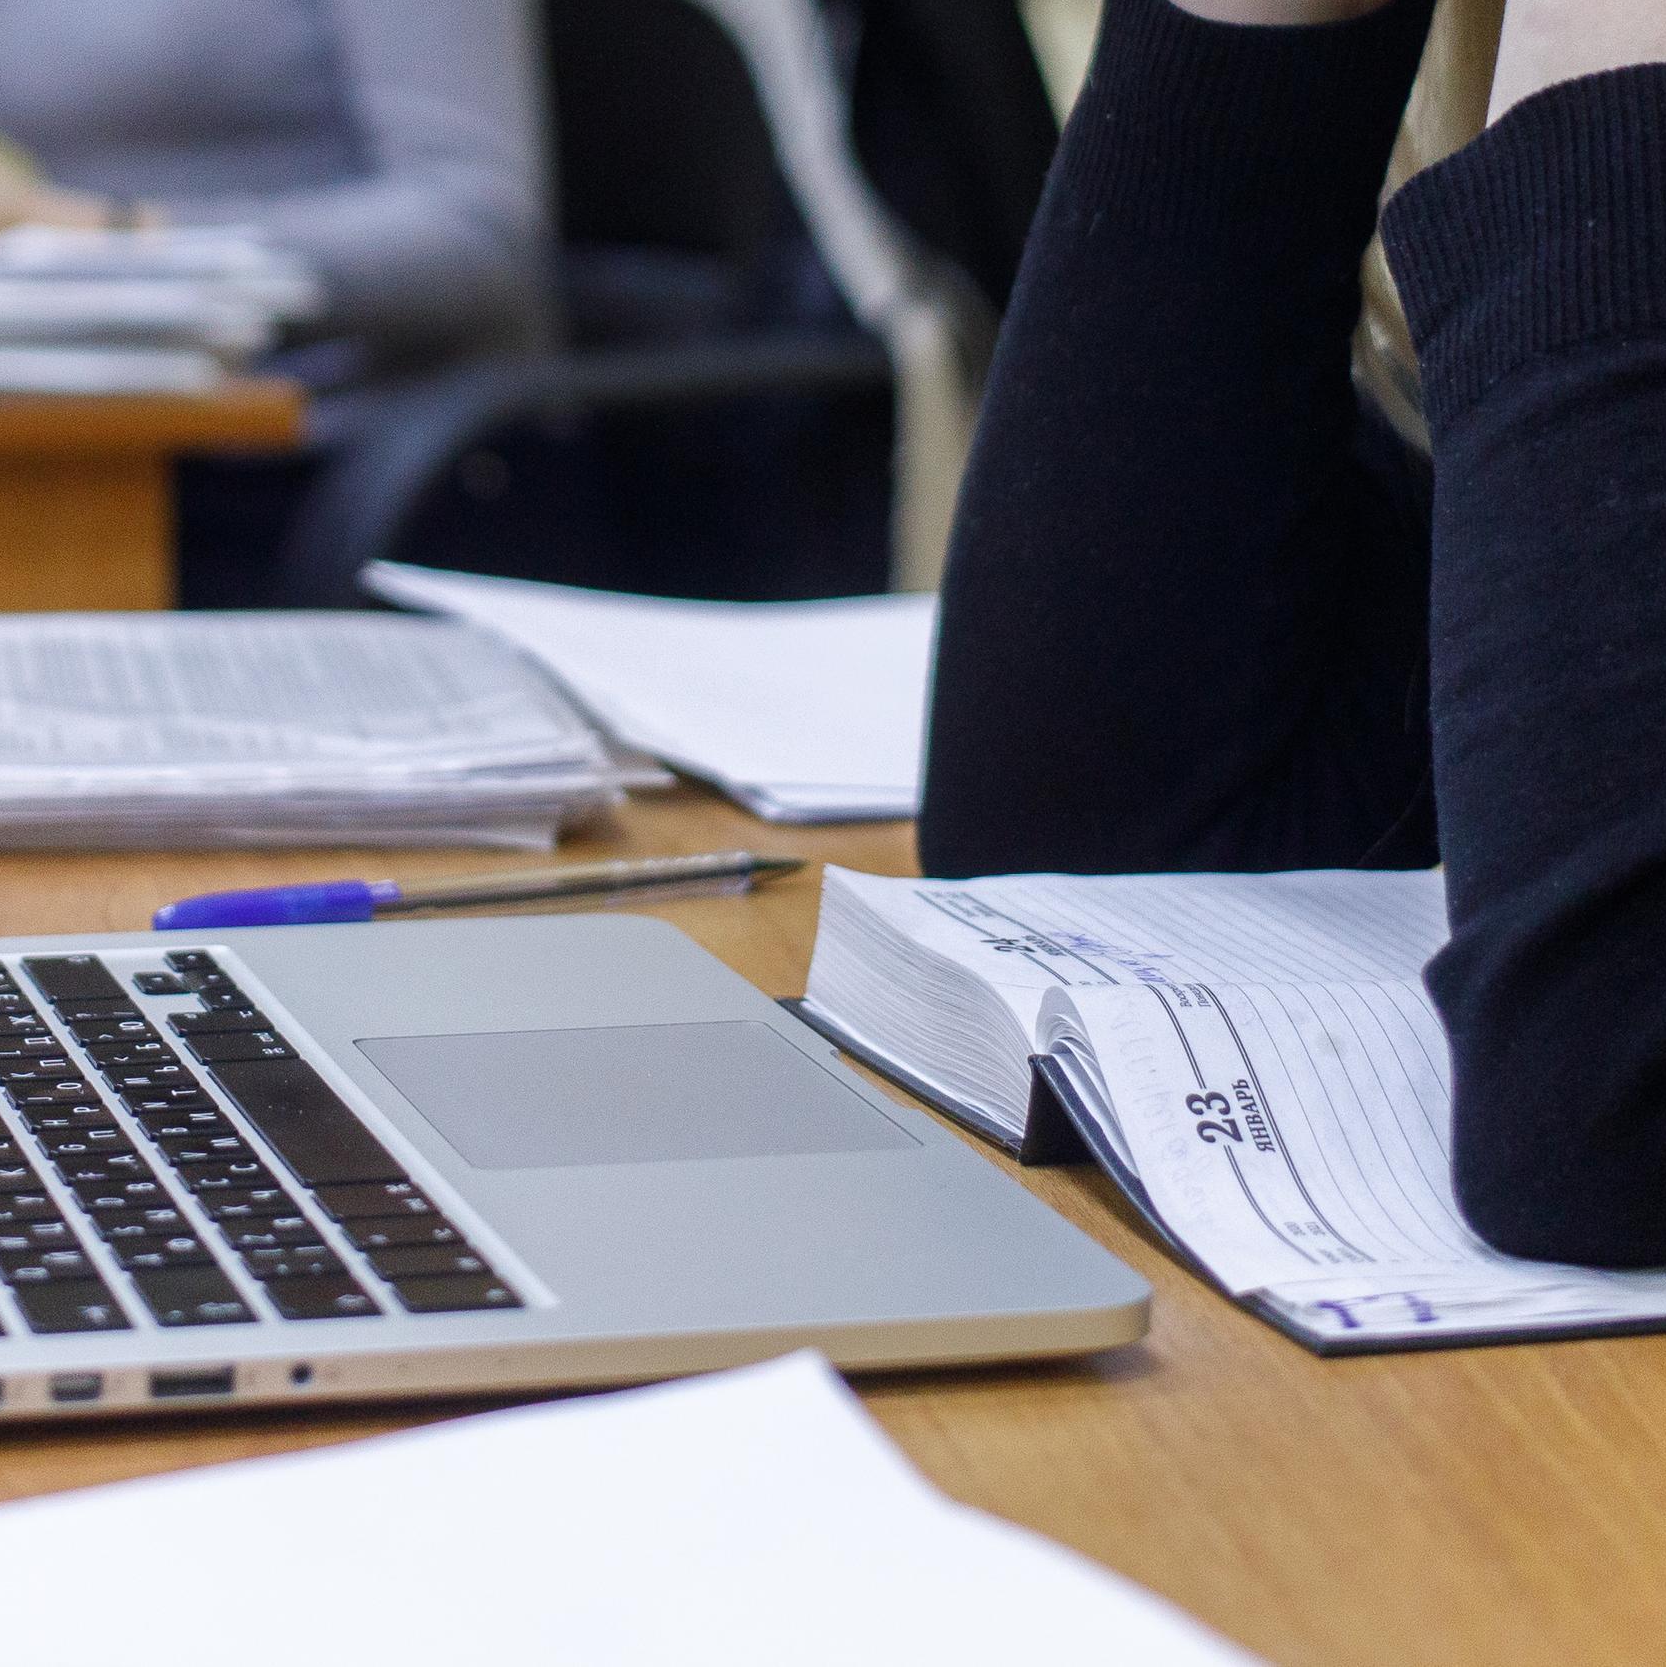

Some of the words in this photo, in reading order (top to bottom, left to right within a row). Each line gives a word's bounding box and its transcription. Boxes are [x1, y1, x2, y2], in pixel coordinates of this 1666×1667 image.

[980, 937, 1037, 953] 24
[8, 1014, 36, 1025] Ж
[118, 1021, 146, 1031] Ю
[24, 1036, 55, 1046] Д
[135, 1043, 161, 1051] Б
[154, 1065, 179, 1073] Ь
[10, 1071, 36, 1079] K
[123, 1077, 151, 1085] M
[56, 1082, 83, 1090] О
[170, 1089, 197, 1097] Т
[142, 1101, 169, 1109] N
[72, 1106, 100, 1114] Р
[189, 1112, 217, 1121] И
[1185, 1091, 1243, 1143] 23
[1231, 1078, 1276, 1153] ЯНВАРЬ
[42, 1119, 69, 1127] H
[88, 1129, 117, 1139] П
[210, 1137, 240, 1148] М
[58, 1143, 87, 1152] G
[108, 1154, 136, 1164] А
[180, 1151, 208, 1159] V
[229, 1163, 258, 1172] С
[200, 1177, 230, 1186] C
[126, 1182, 156, 1192] В
[251, 1189, 278, 1200] Ч
[15, 1195, 45, 1205] У
[94, 1197, 125, 1206] D
[221, 1204, 251, 1214] X
